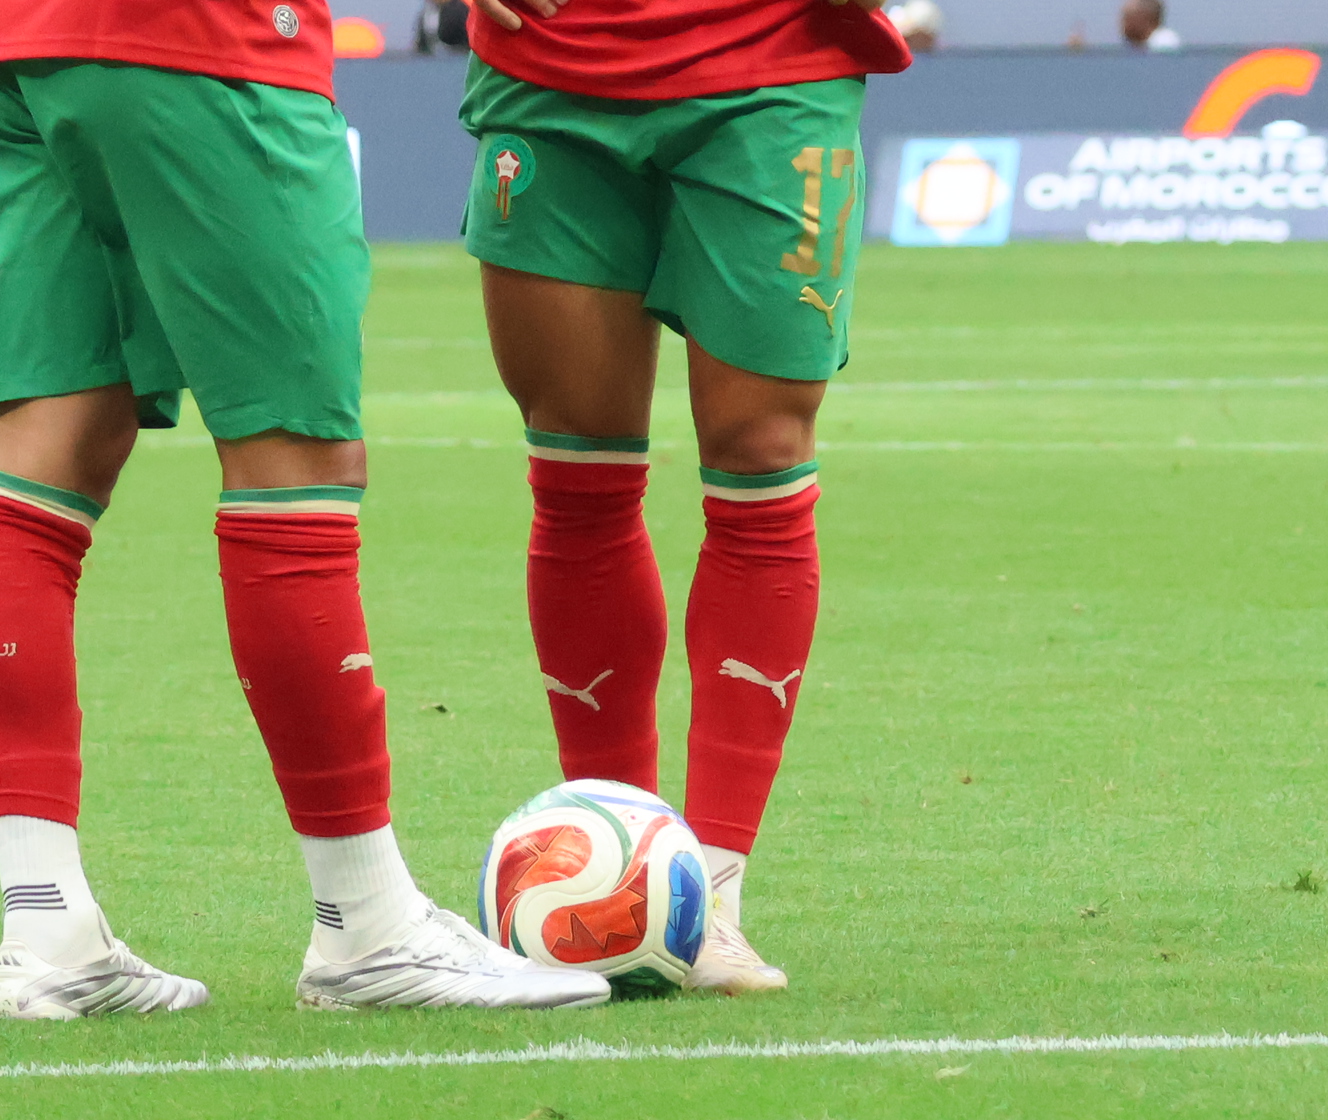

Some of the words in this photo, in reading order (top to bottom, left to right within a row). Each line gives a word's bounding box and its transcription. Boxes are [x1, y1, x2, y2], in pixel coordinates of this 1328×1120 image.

[1069, 136, 1328, 171] AIRPORTS
[1024, 173, 1098, 210] OF
[780, 146, 856, 279] 17
